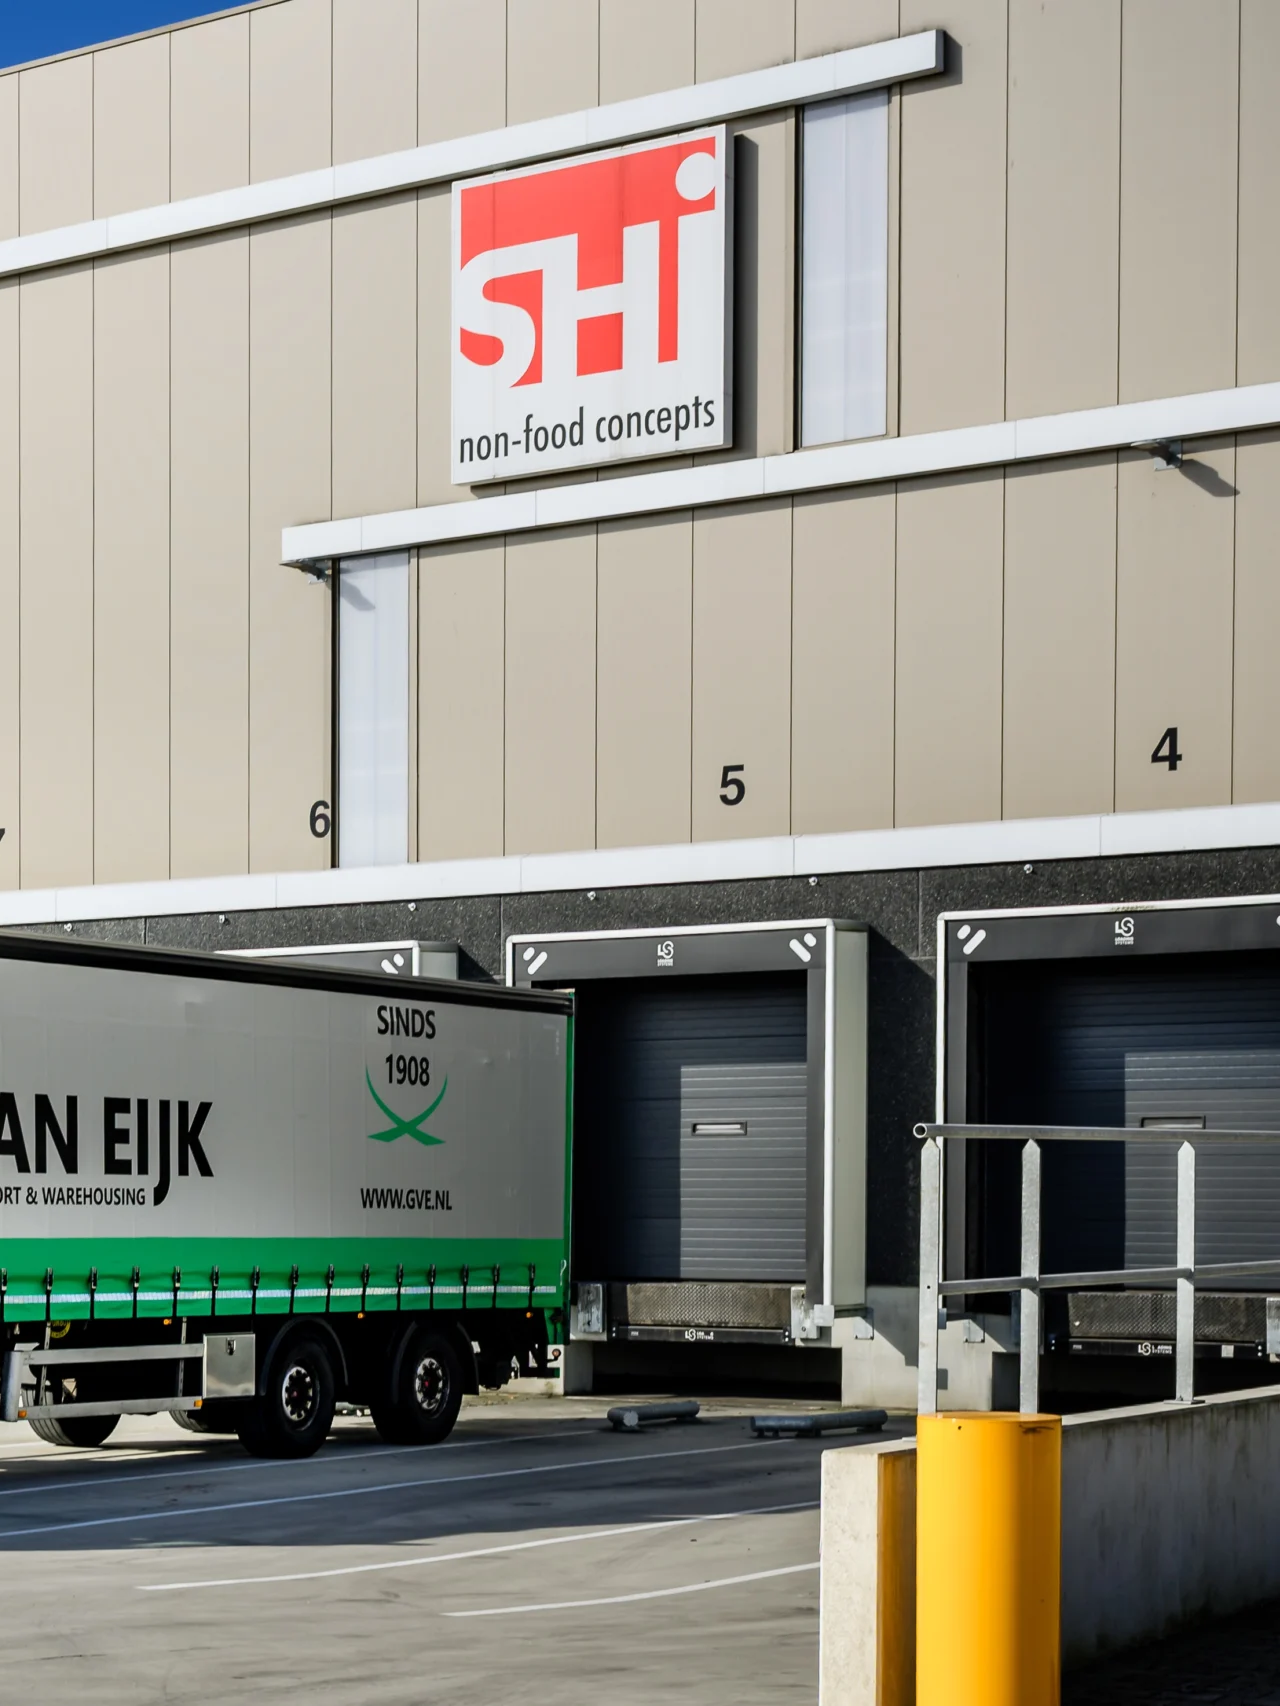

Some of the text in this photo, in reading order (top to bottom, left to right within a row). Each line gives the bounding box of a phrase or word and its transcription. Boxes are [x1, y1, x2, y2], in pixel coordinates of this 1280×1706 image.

[459, 395, 716, 464] non-food concepts
[1151, 727, 1183, 772] 4
[718, 764, 746, 806] 5
[309, 800, 331, 838] 6
[1114, 917, 1134, 937] LS
[657, 940, 674, 959] LS
[377, 1004, 437, 1040] SINDS
[385, 1053, 431, 1087] 1908
[103, 1096, 214, 1207] EIJK
[25, 1186, 38, 1205] &
[41, 1187, 146, 1206] WAREHOUSING
[360, 1187, 453, 1211] WWW.GVE.NL
[1138, 1342, 1151, 1356] LS
